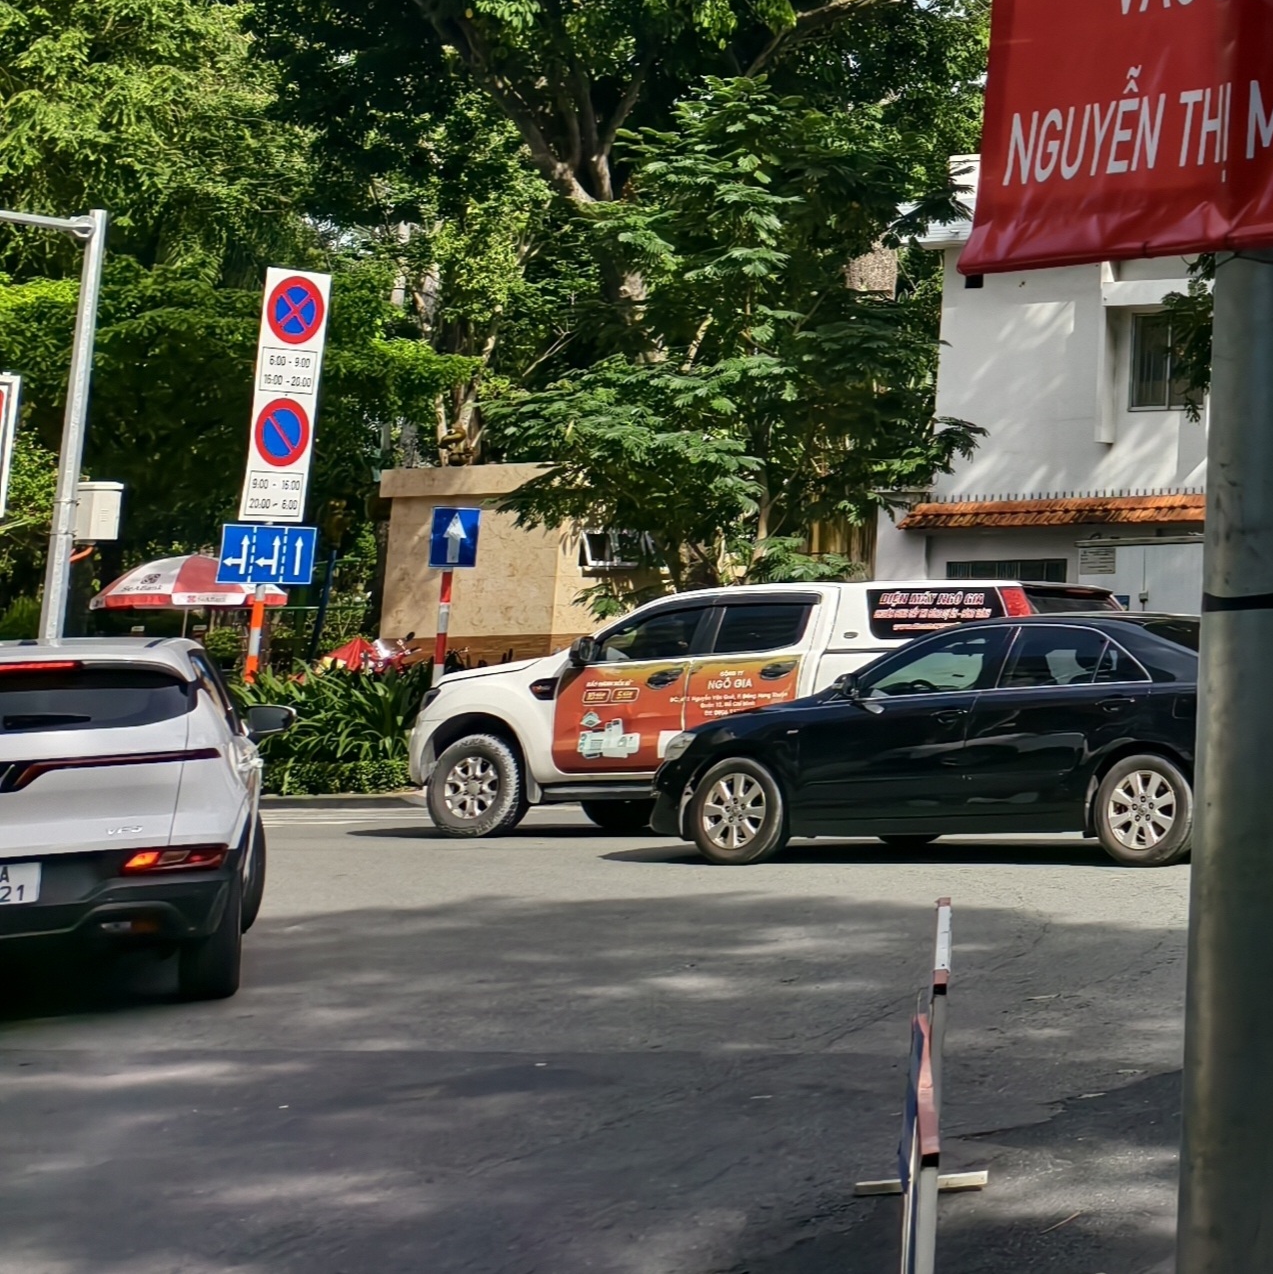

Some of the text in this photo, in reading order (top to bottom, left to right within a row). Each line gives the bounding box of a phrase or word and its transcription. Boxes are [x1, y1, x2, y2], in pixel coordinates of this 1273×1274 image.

[1002, 65, 1166, 186] NGUYỄN
[1179, 82, 1232, 182] THỊ
[269, 355, 286, 366] 6:00
[294, 357, 311, 368] 9:00
[291, 376, 312, 387] 20:00
[252, 478, 269, 490] 9:00
[249, 498, 271, 509] 20:00
[707, 677, 753, 690] NGÔ GIA
